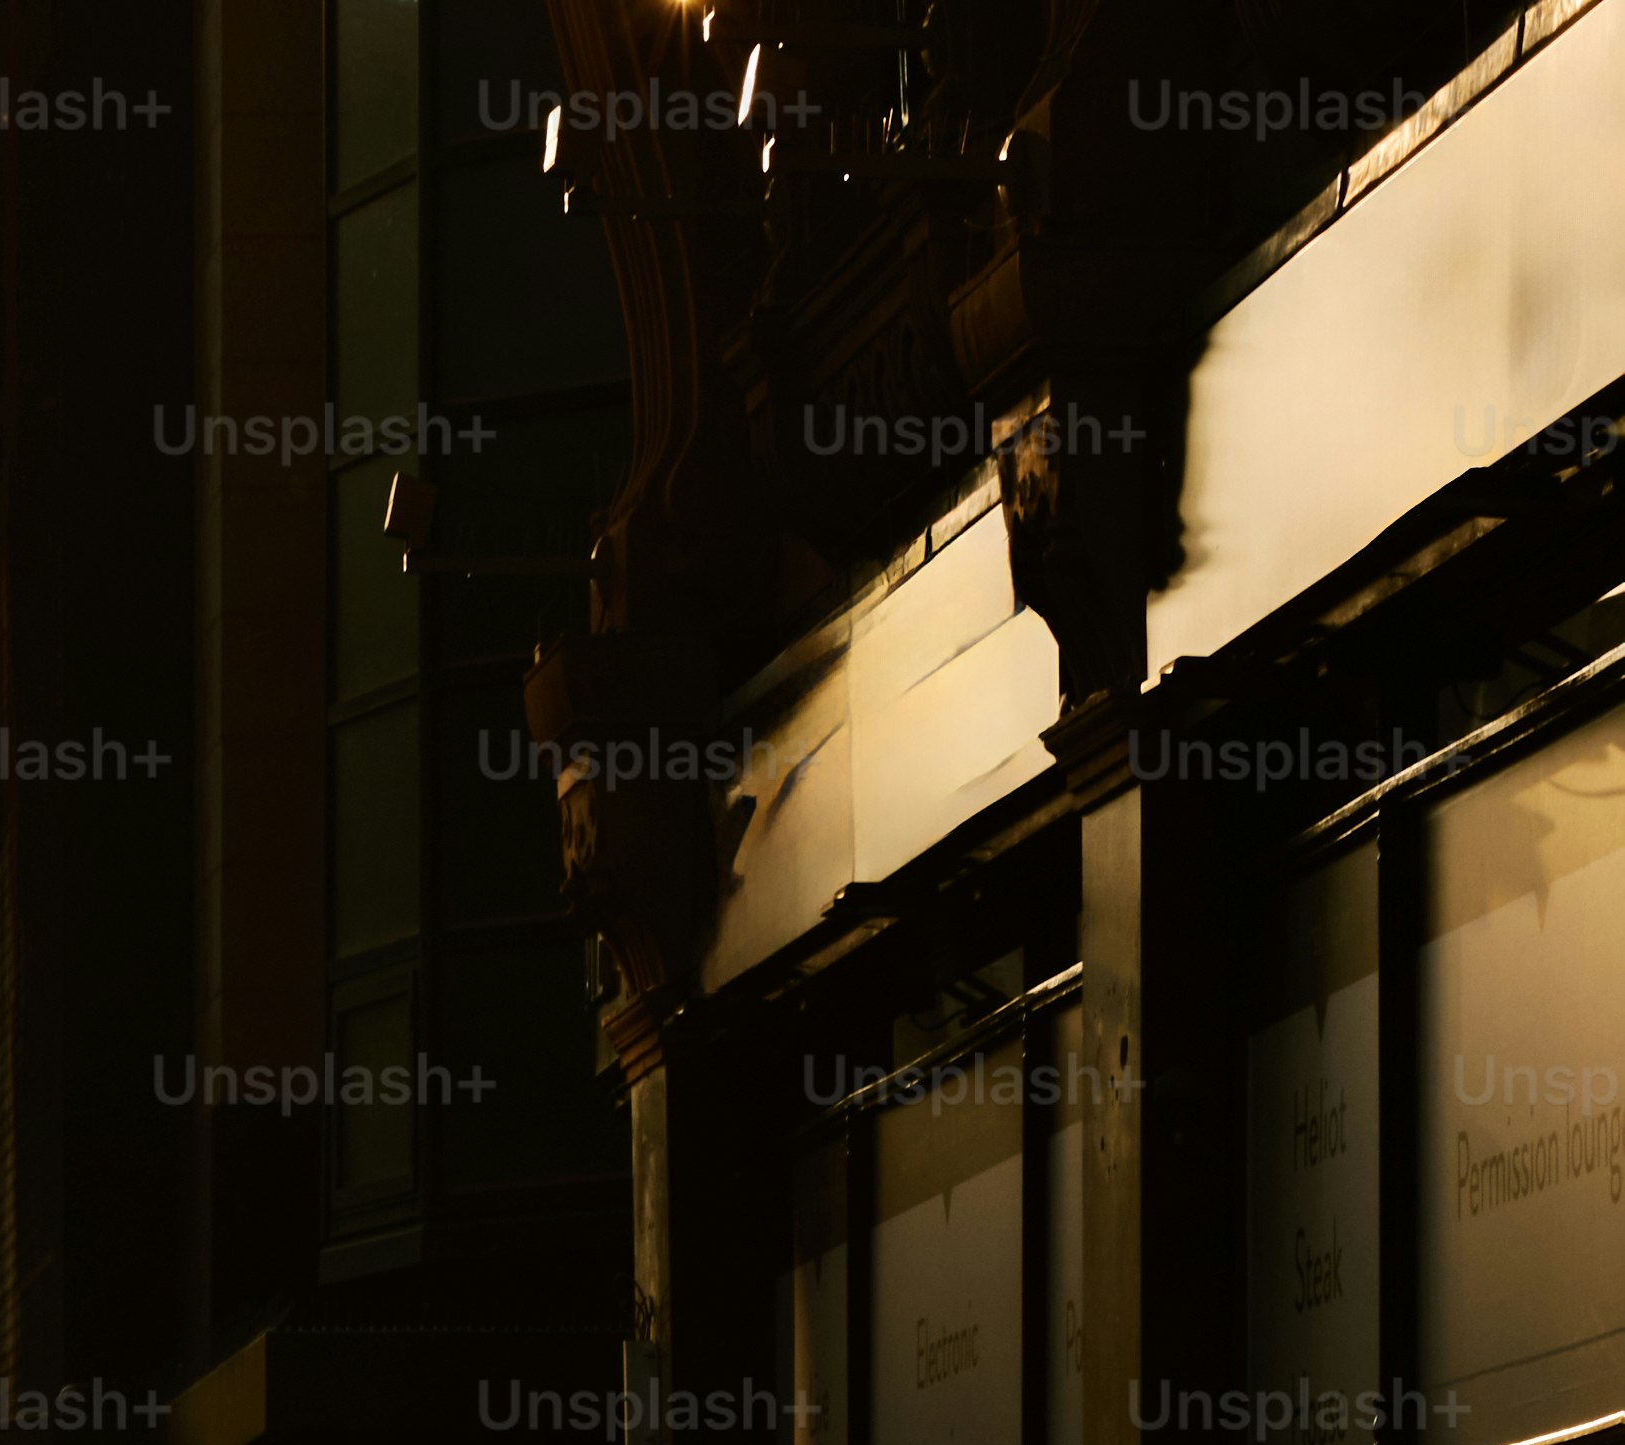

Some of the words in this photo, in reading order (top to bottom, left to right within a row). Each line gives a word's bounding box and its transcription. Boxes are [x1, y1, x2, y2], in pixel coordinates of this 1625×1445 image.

[1293, 1080, 1347, 1172] Heliot
[1456, 1105, 1559, 1221] Permission
[1566, 1101, 1625, 1205] loung
[1294, 1216, 1343, 1314] Steak
[916, 1299, 979, 1389] Electronic
